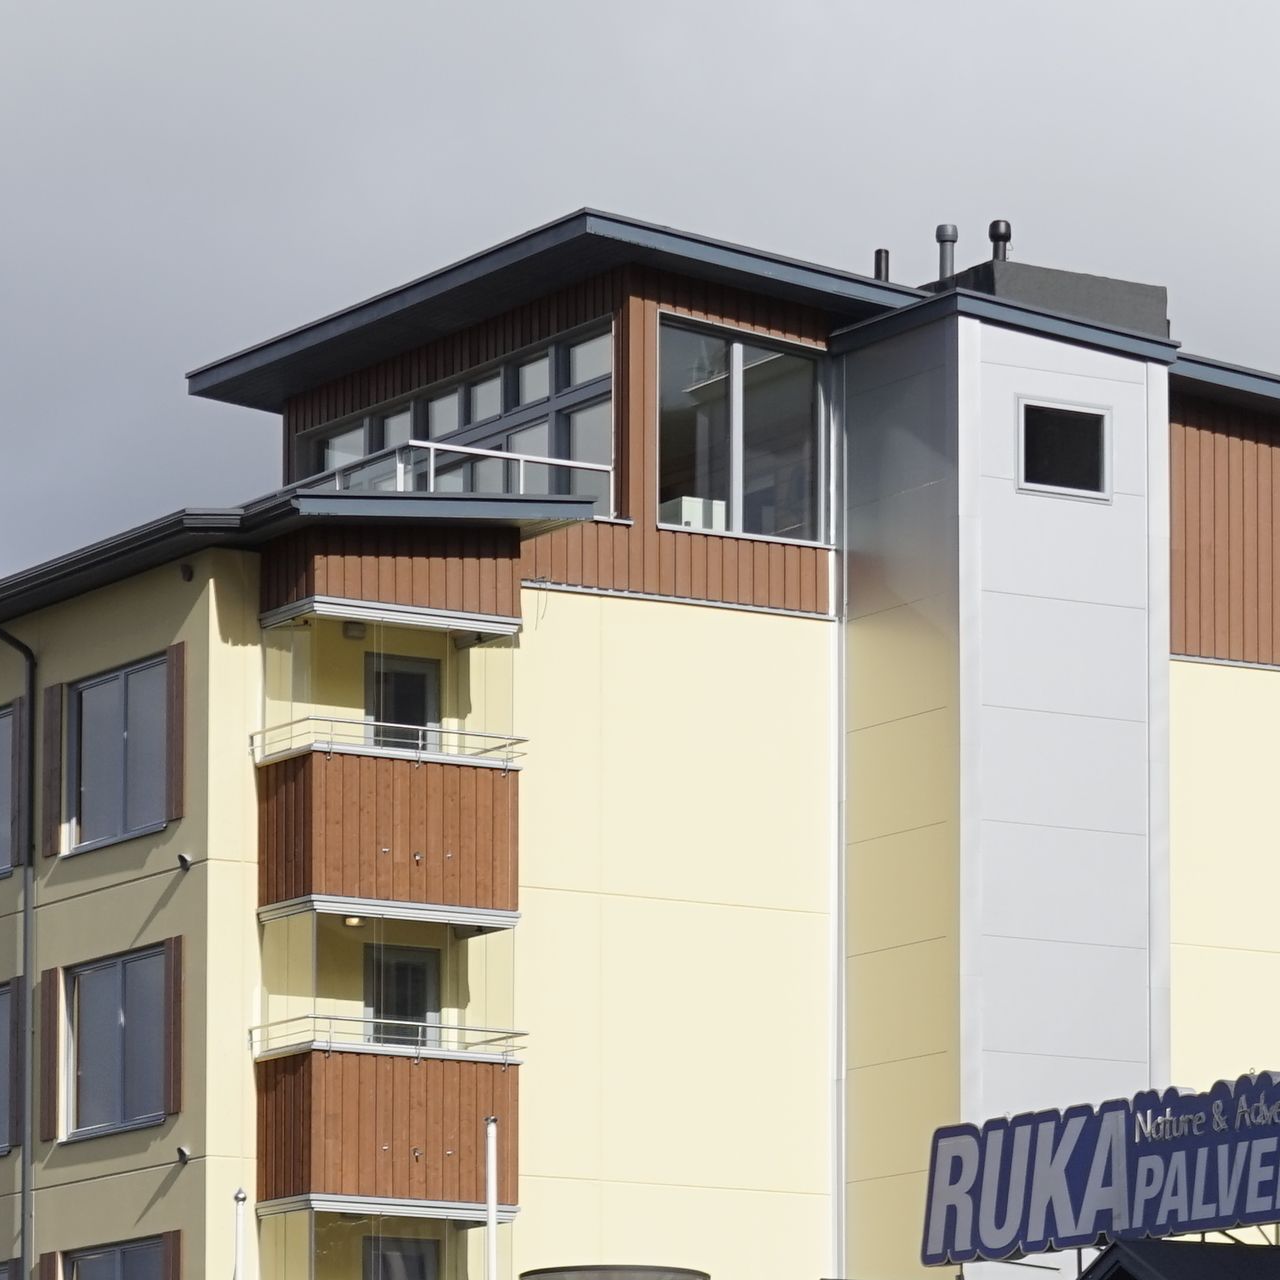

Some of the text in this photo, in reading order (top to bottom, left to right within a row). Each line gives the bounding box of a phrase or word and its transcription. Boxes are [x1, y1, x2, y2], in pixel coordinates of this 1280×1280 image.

[1134, 1108, 1206, 1144] Nature
[1212, 1098, 1229, 1132] &
[926, 1110, 1132, 1257] RUKA
